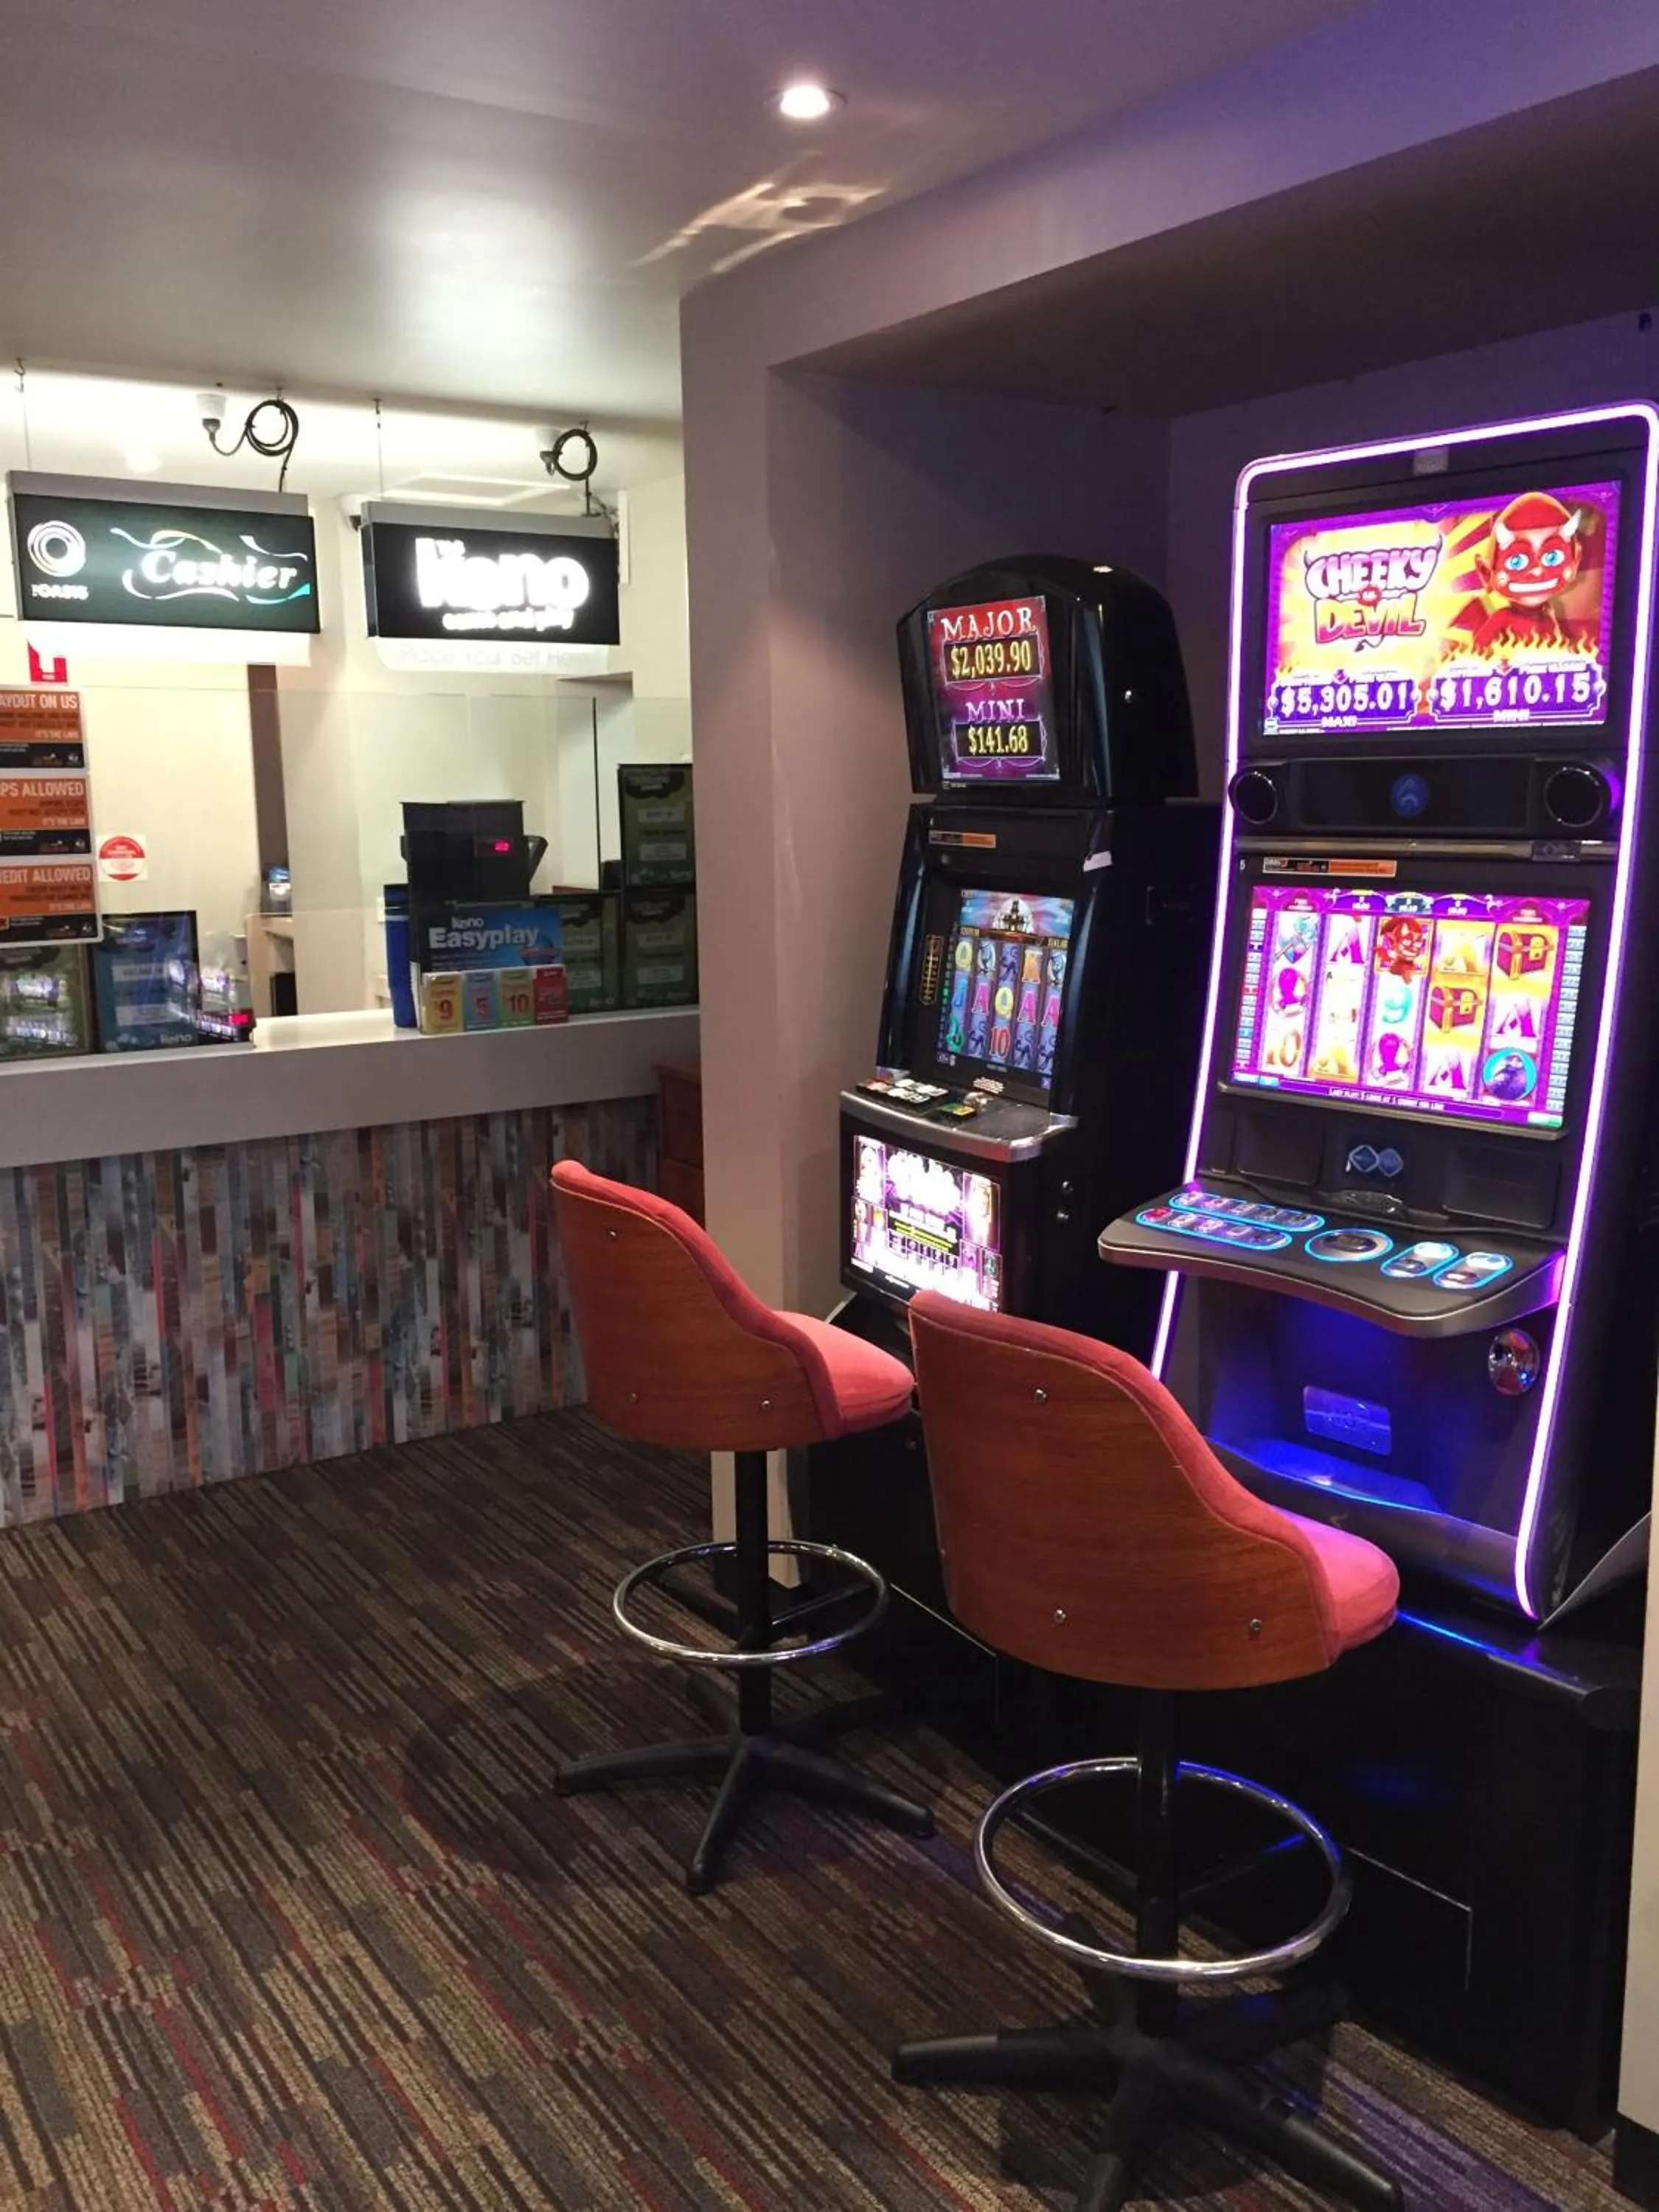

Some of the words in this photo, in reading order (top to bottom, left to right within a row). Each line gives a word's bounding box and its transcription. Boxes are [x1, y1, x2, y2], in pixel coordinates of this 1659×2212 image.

[141, 550, 298, 589] Cashier
[1306, 546, 1439, 599] CHEEKY
[941, 606, 1037, 641] MAJOR
[1315, 591, 1427, 644] DEVIL
[950, 639, 1032, 679] $2,039.90
[39, 694, 58, 709] ON
[60, 695, 77, 709] US
[1281, 682, 1408, 718] $5,305.01
[1440, 672, 1590, 712] $1,610.15
[965, 698, 1026, 723] MINI
[967, 724, 1029, 756] $141.68
[22, 781, 85, 797] ALLOWED
[32, 866, 91, 883] ALLOWED
[428, 925, 540, 950] Easyplay
[451, 916, 484, 930] keno
